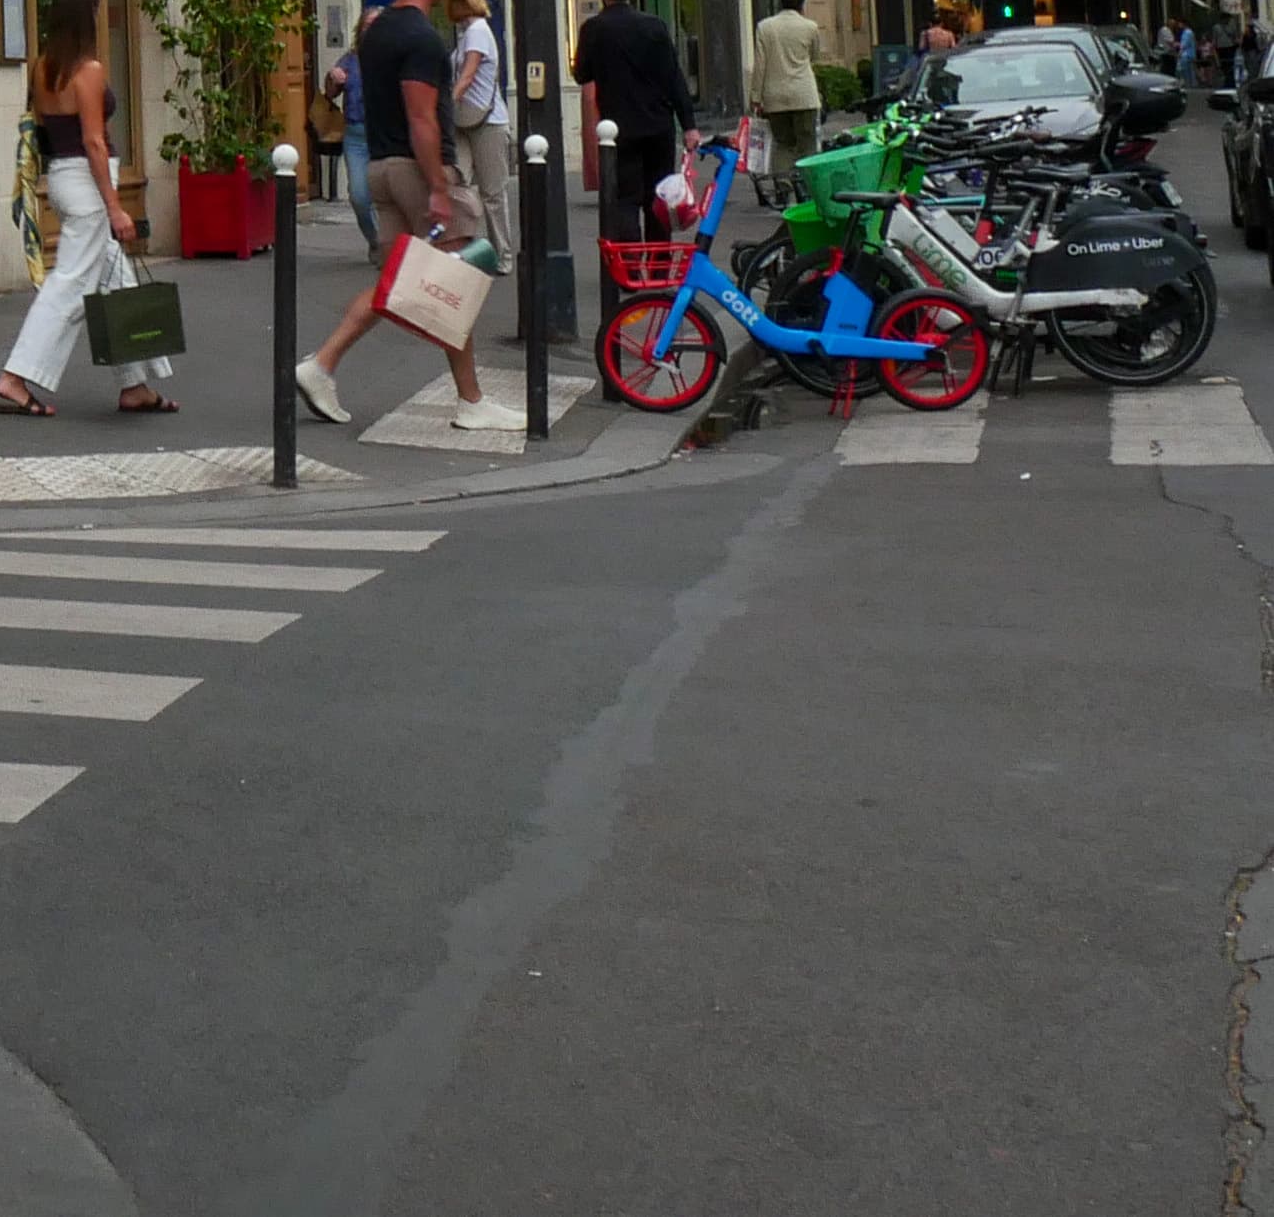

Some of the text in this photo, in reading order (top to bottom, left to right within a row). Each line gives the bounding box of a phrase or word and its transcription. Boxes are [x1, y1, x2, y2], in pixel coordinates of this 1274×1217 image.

[1067, 243, 1088, 257] On
[1089, 240, 1121, 254] Lime
[1131, 236, 1164, 250] Uber
[721, 289, 760, 328] dott
